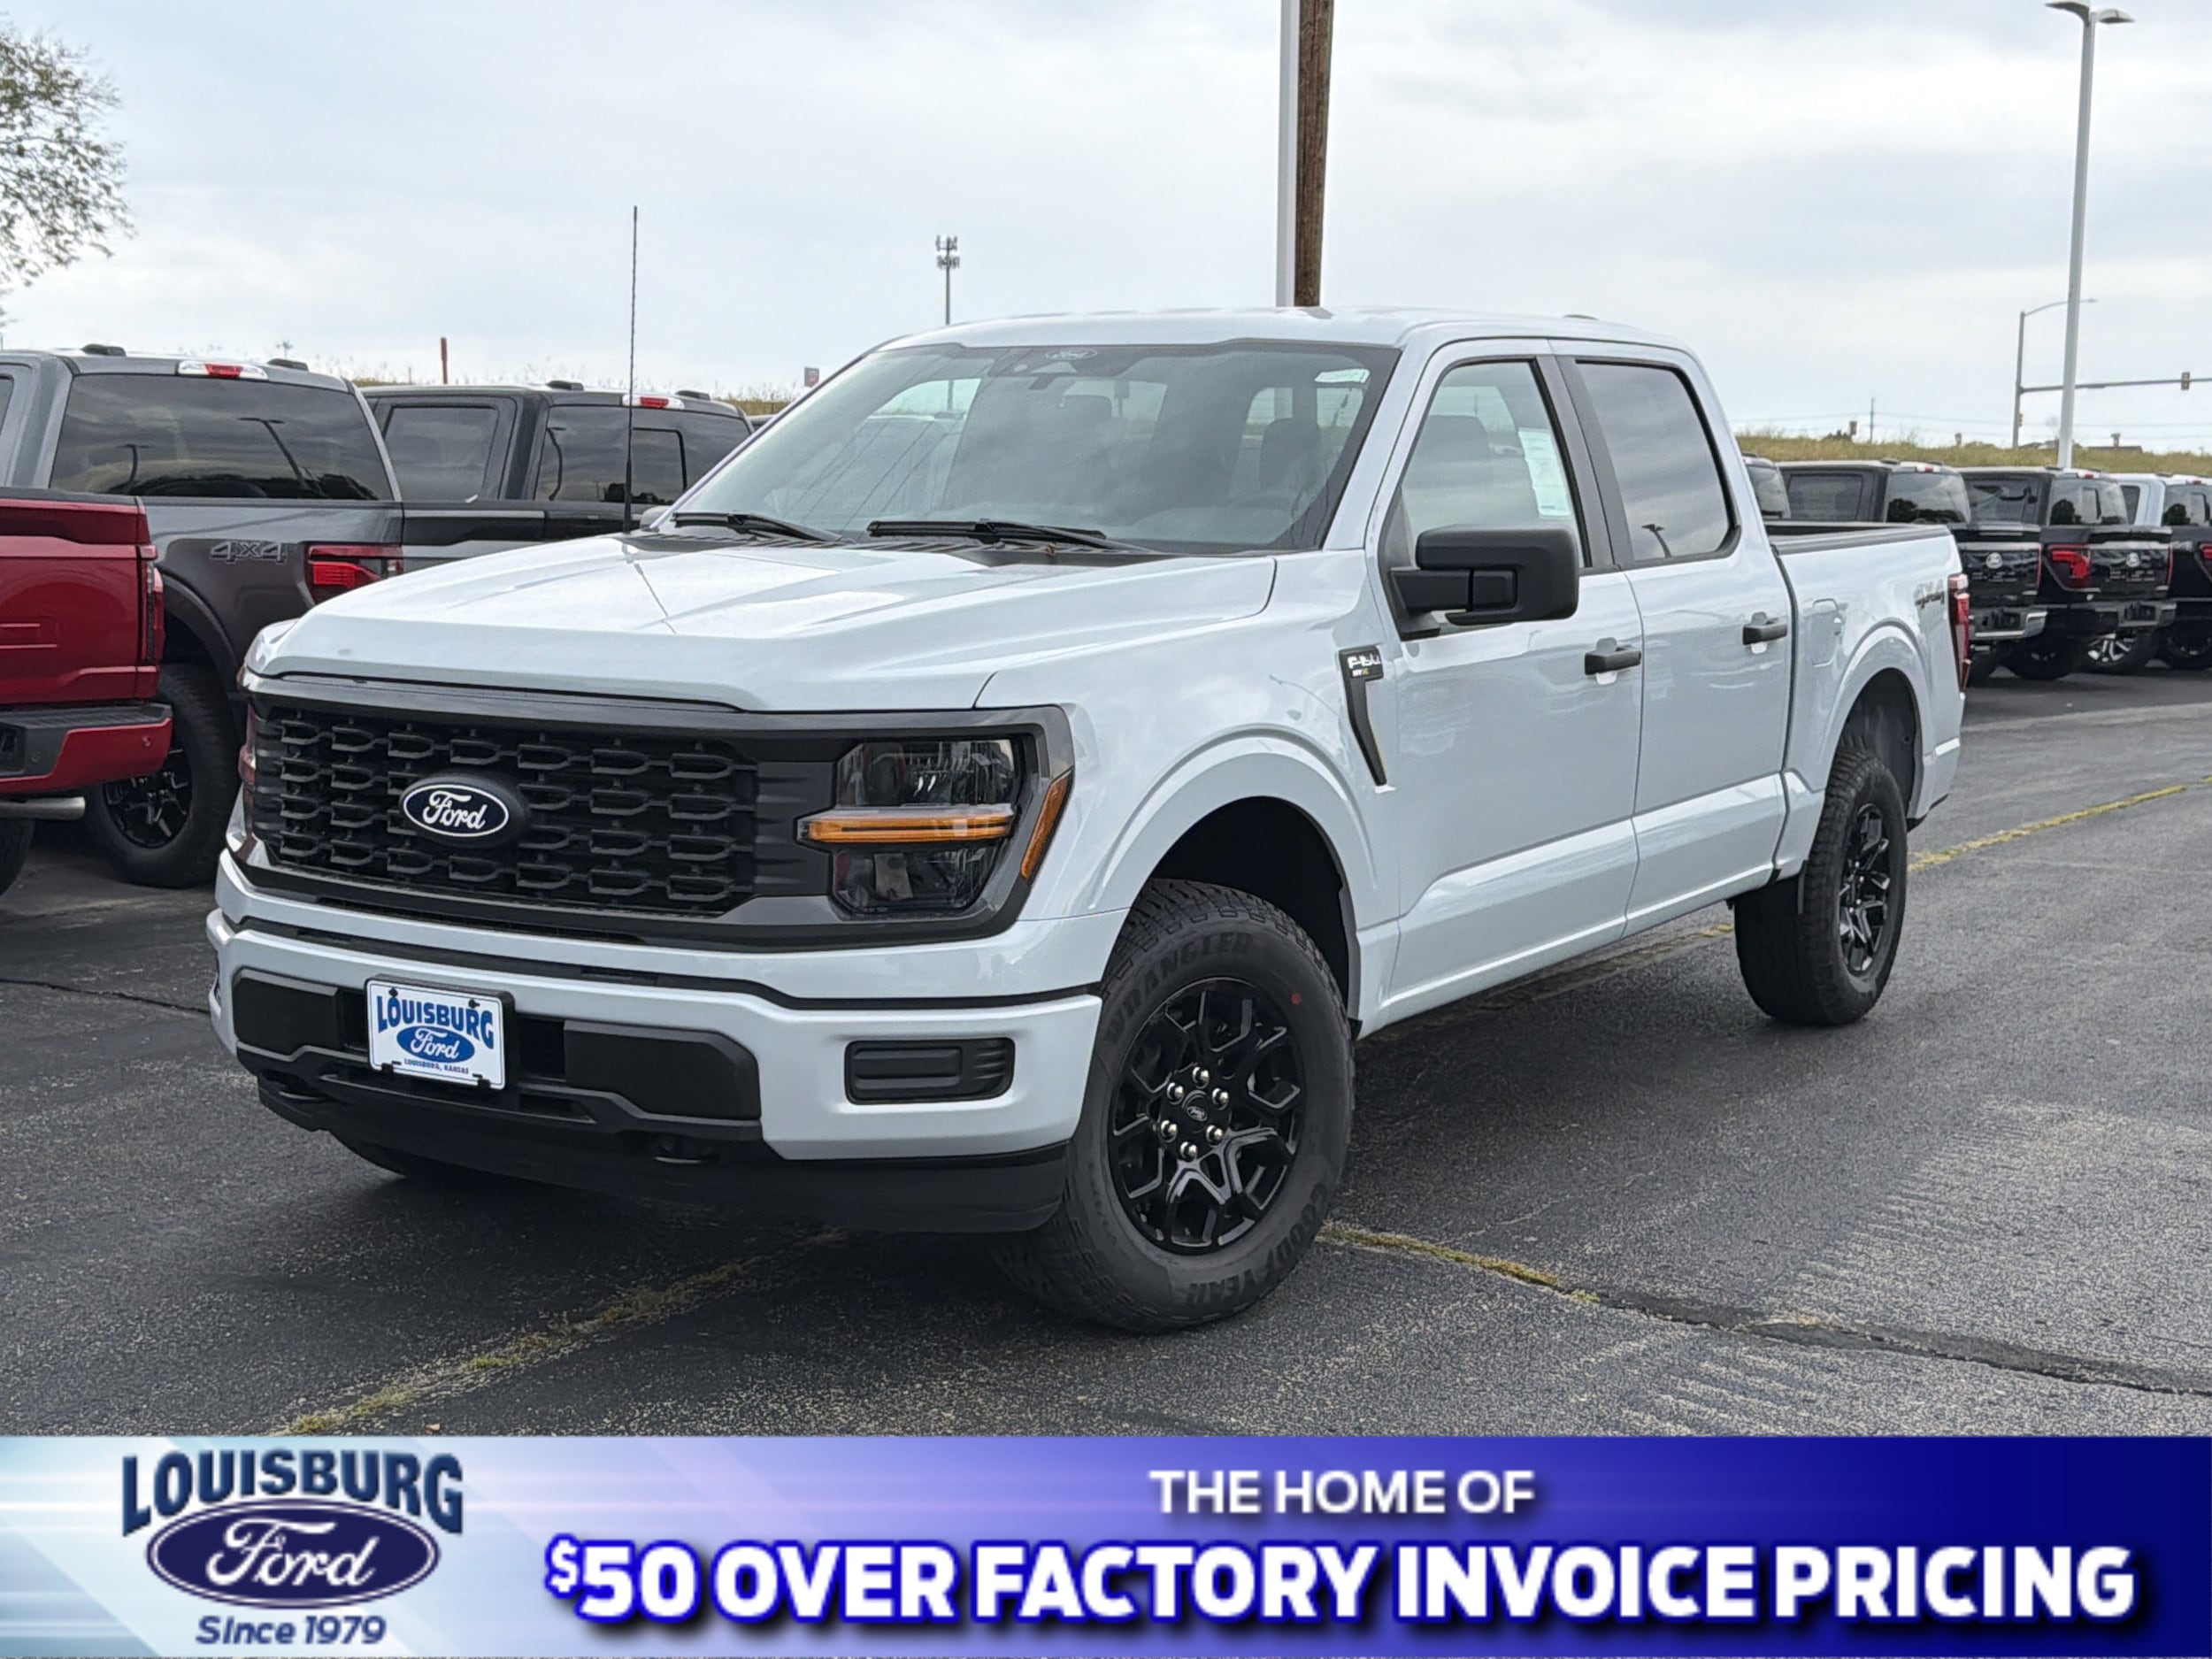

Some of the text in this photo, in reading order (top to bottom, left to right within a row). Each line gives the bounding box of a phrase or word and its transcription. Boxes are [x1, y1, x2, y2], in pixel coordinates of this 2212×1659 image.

[422, 790, 488, 830] Ford
[1103, 932, 1253, 1042] WRANGLER
[376, 995, 495, 1050] LOUISBURG
[411, 1027, 460, 1059] Ford
[443, 1064, 470, 1076] KANSAS
